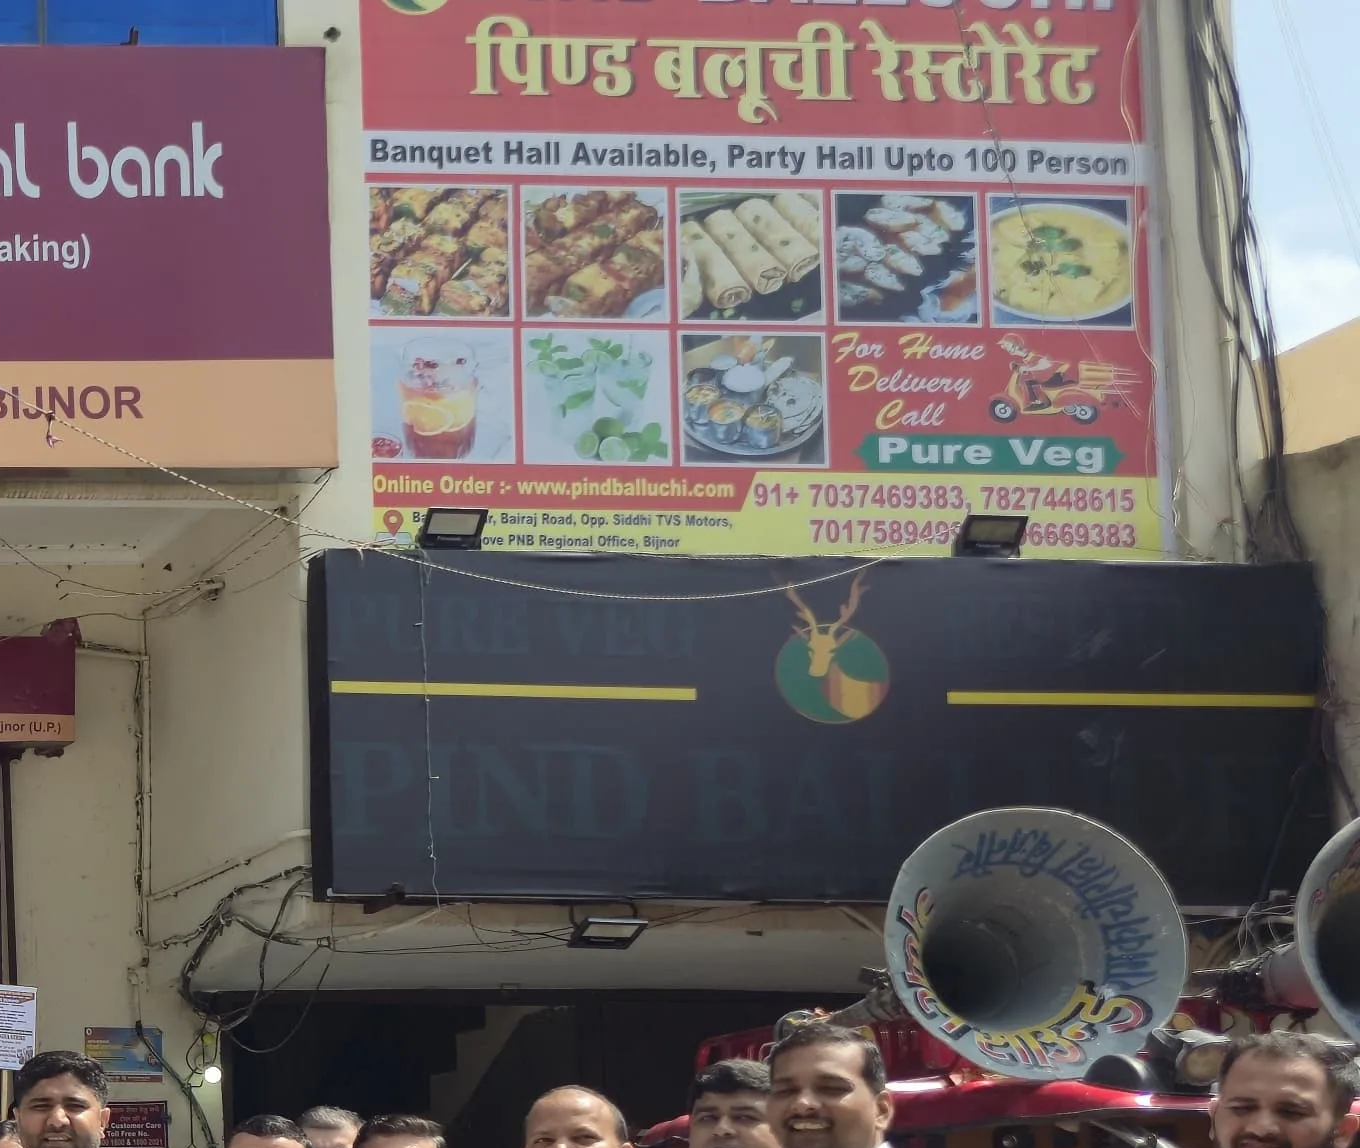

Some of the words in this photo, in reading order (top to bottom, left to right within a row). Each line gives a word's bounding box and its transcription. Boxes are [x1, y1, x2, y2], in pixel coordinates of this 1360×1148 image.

[465, 15, 637, 97] पिण्ड
[647, 20, 854, 125] बलूची
[858, 17, 1100, 105] रेस्टोरेंट
[68, 121, 224, 199] bank
[370, 139, 493, 170] Banquet
[503, 141, 560, 165] Hall
[571, 142, 718, 173] Available,
[727, 144, 806, 175] Party
[815, 146, 873, 171] Hall
[884, 147, 954, 176] Upto
[965, 148, 1017, 173] 100
[1027, 149, 1128, 175] Person
[831, 332, 885, 364] For
[898, 332, 985, 360] Home
[847, 364, 973, 400] Delivery
[875, 399, 946, 430] Call
[878, 437, 993, 465] Pure
[1008, 439, 1105, 474] Veg
[373, 475, 433, 494] Online
[440, 476, 494, 495] Order
[518, 479, 734, 499] www.pindballuchi.com
[753, 483, 799, 507] 91+
[809, 484, 972, 512] 7037469383,
[980, 486, 1135, 512] 7827448615
[500, 512, 537, 528] Bairaj
[541, 513, 577, 528] Road,
[580, 513, 609, 529] Opp.
[612, 513, 652, 527] Siddhi
[655, 514, 681, 527] TVS
[685, 515, 733, 529] Motors,
[508, 534, 534, 546] PNB
[538, 535, 593, 550] Regional
[597, 535, 639, 549] Office,
[643, 535, 680, 550] Bijnor
[29, 721, 61, 735] (U.P.)
